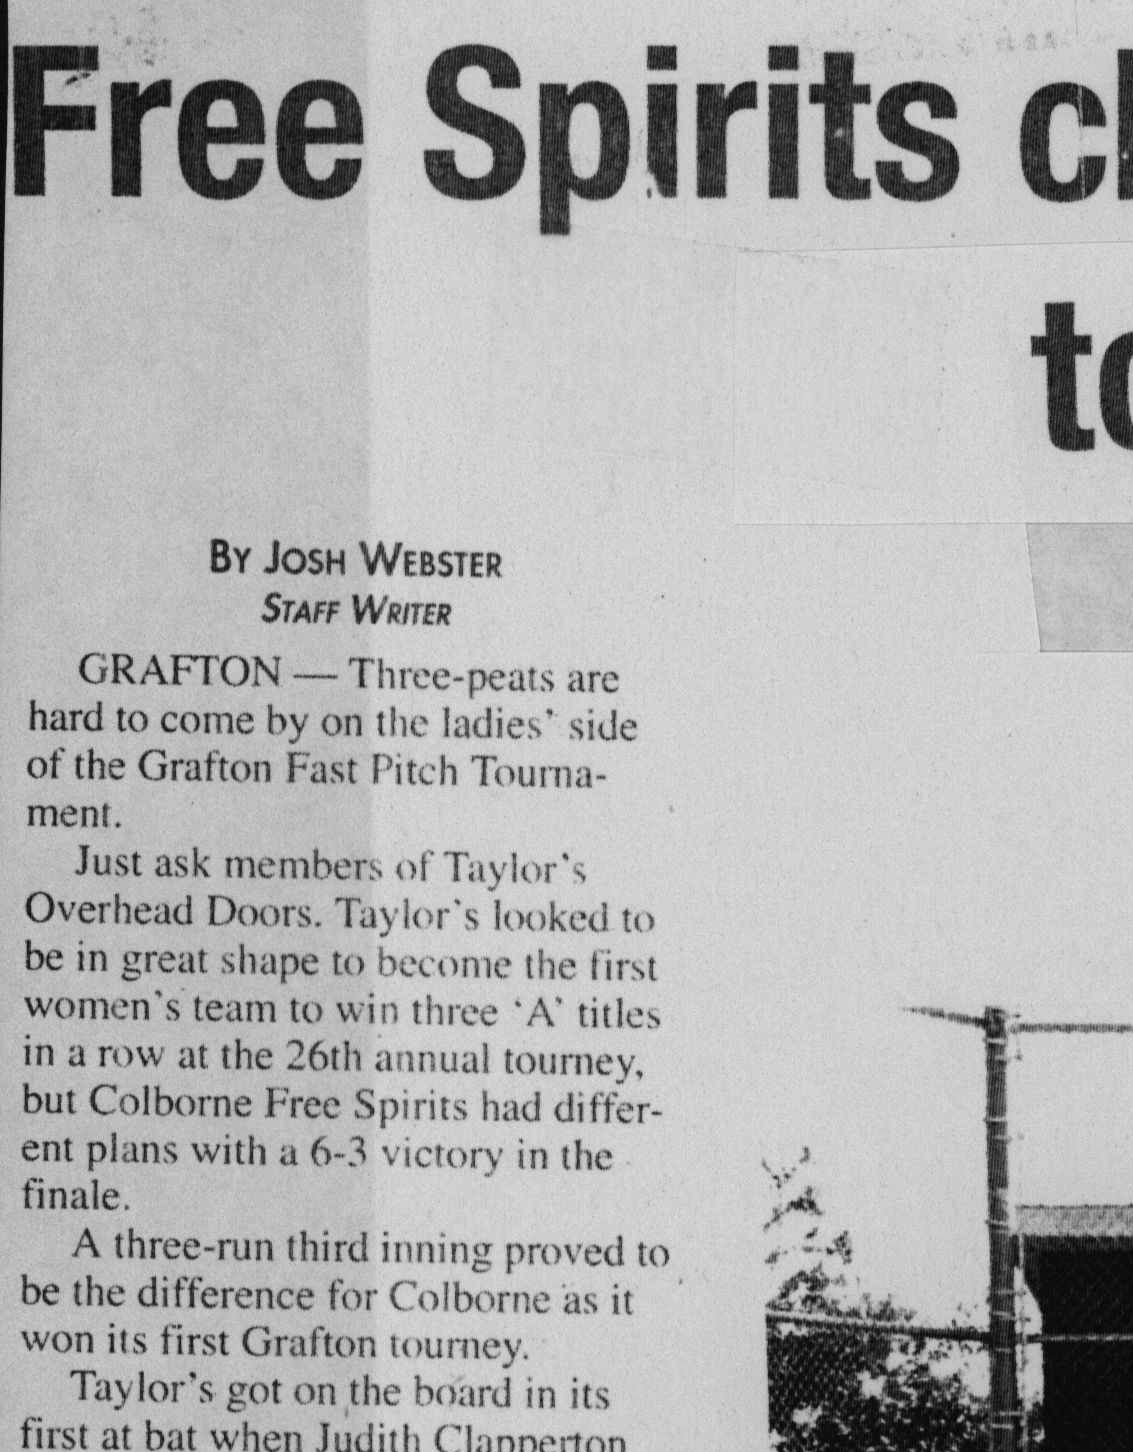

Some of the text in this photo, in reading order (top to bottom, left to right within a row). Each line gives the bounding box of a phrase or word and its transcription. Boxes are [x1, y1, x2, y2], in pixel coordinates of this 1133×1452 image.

[13, 45, 363, 200] Free
[424, 44, 959, 235] Spirits
[28, 698, 638, 745] hard to come by on the ladies' side
[26, 746, 607, 789] of the Grafton Fast Pitch Tourna-
[74, 844, 587, 893] Just ask members of Taylor's
[23, 989, 662, 1030] women's team to win three 'A' titles
[22, 1081, 663, 1130] but Colborne Free Spirits had differ-
[22, 1176, 130, 1212] finale.
[71, 1227, 671, 1275] A three-run third inning proved to
[19, 1415, 89, 1451] first
[100, 1424, 132, 1452] at
[144, 1418, 197, 1452] bat
